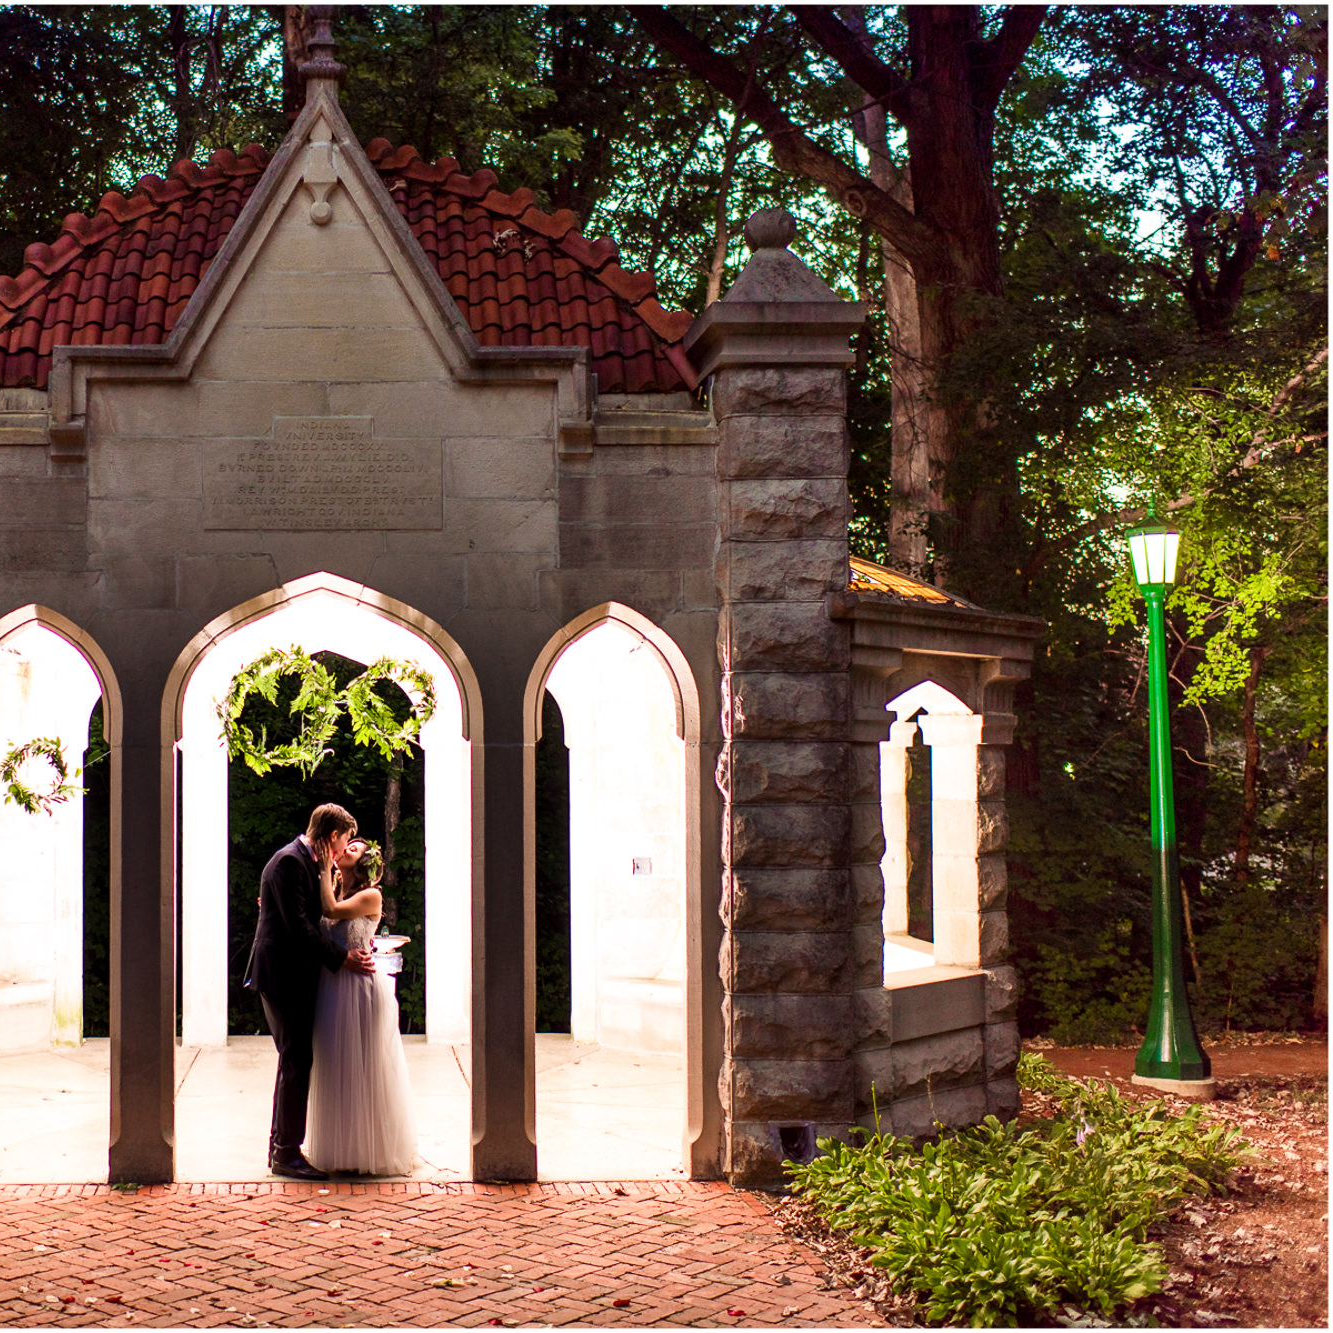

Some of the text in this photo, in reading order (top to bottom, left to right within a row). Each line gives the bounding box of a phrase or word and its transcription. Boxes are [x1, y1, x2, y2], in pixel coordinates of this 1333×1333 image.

[296, 421, 350, 430] INDIANA
[219, 464, 273, 473] BVRNED
[279, 464, 317, 473] DOWN
